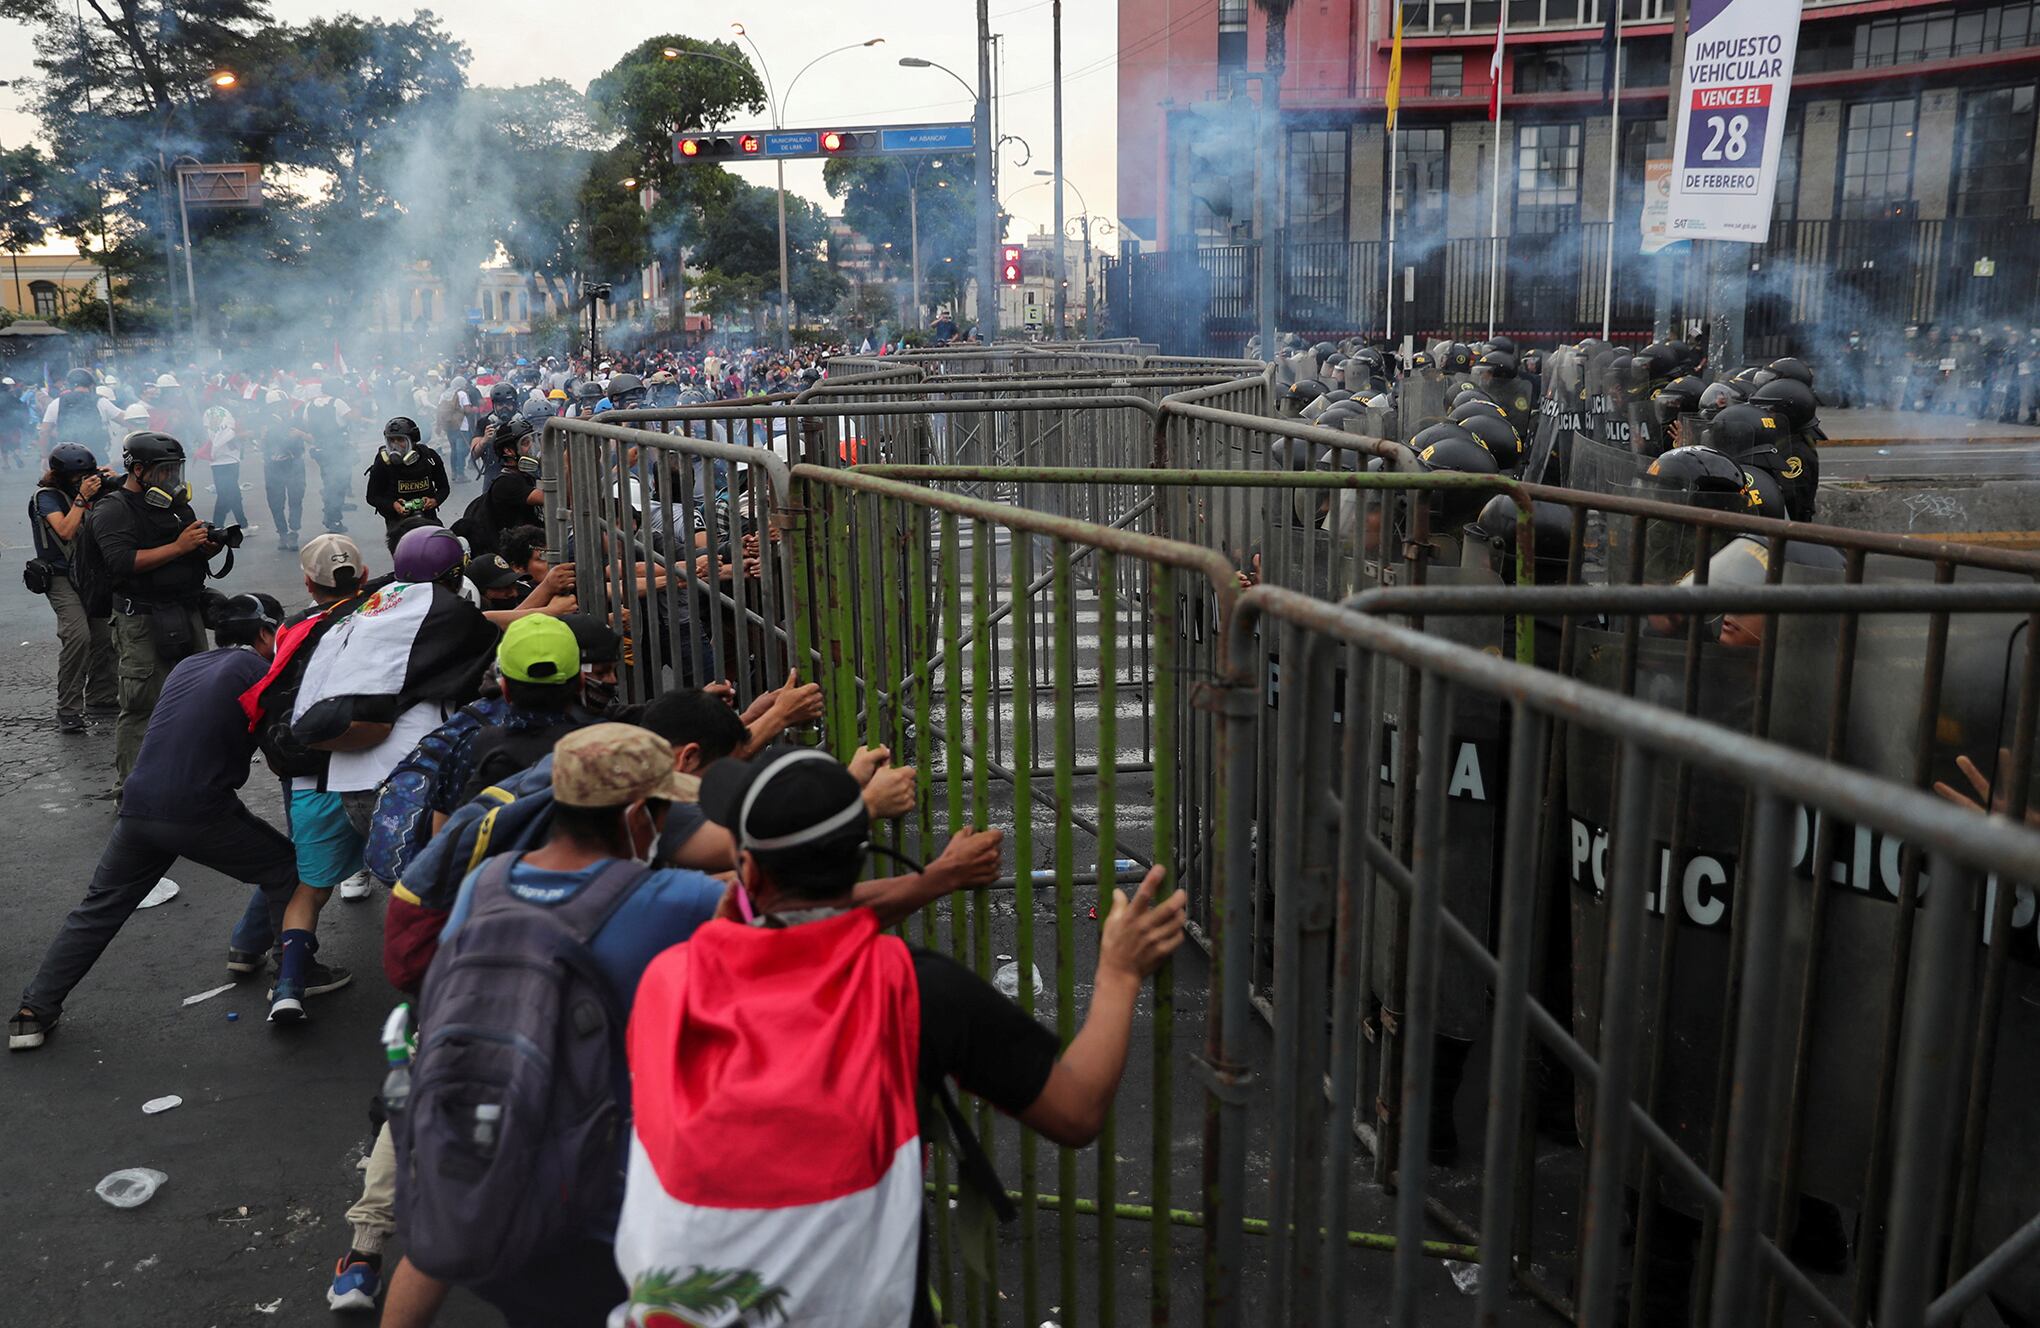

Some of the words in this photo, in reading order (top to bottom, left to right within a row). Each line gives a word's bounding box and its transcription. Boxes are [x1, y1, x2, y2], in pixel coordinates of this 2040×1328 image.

[1696, 35, 1782, 61] IMPUESTO
[1690, 58, 1783, 83] VEHICULAR
[1701, 90, 1744, 107] VENCE
[1745, 88, 1761, 104] EL
[1702, 114, 1749, 160] 28
[1686, 175, 1700, 188] DE
[1703, 175, 1755, 188] FEBRERO
[400, 480, 428, 490] PRENSA
